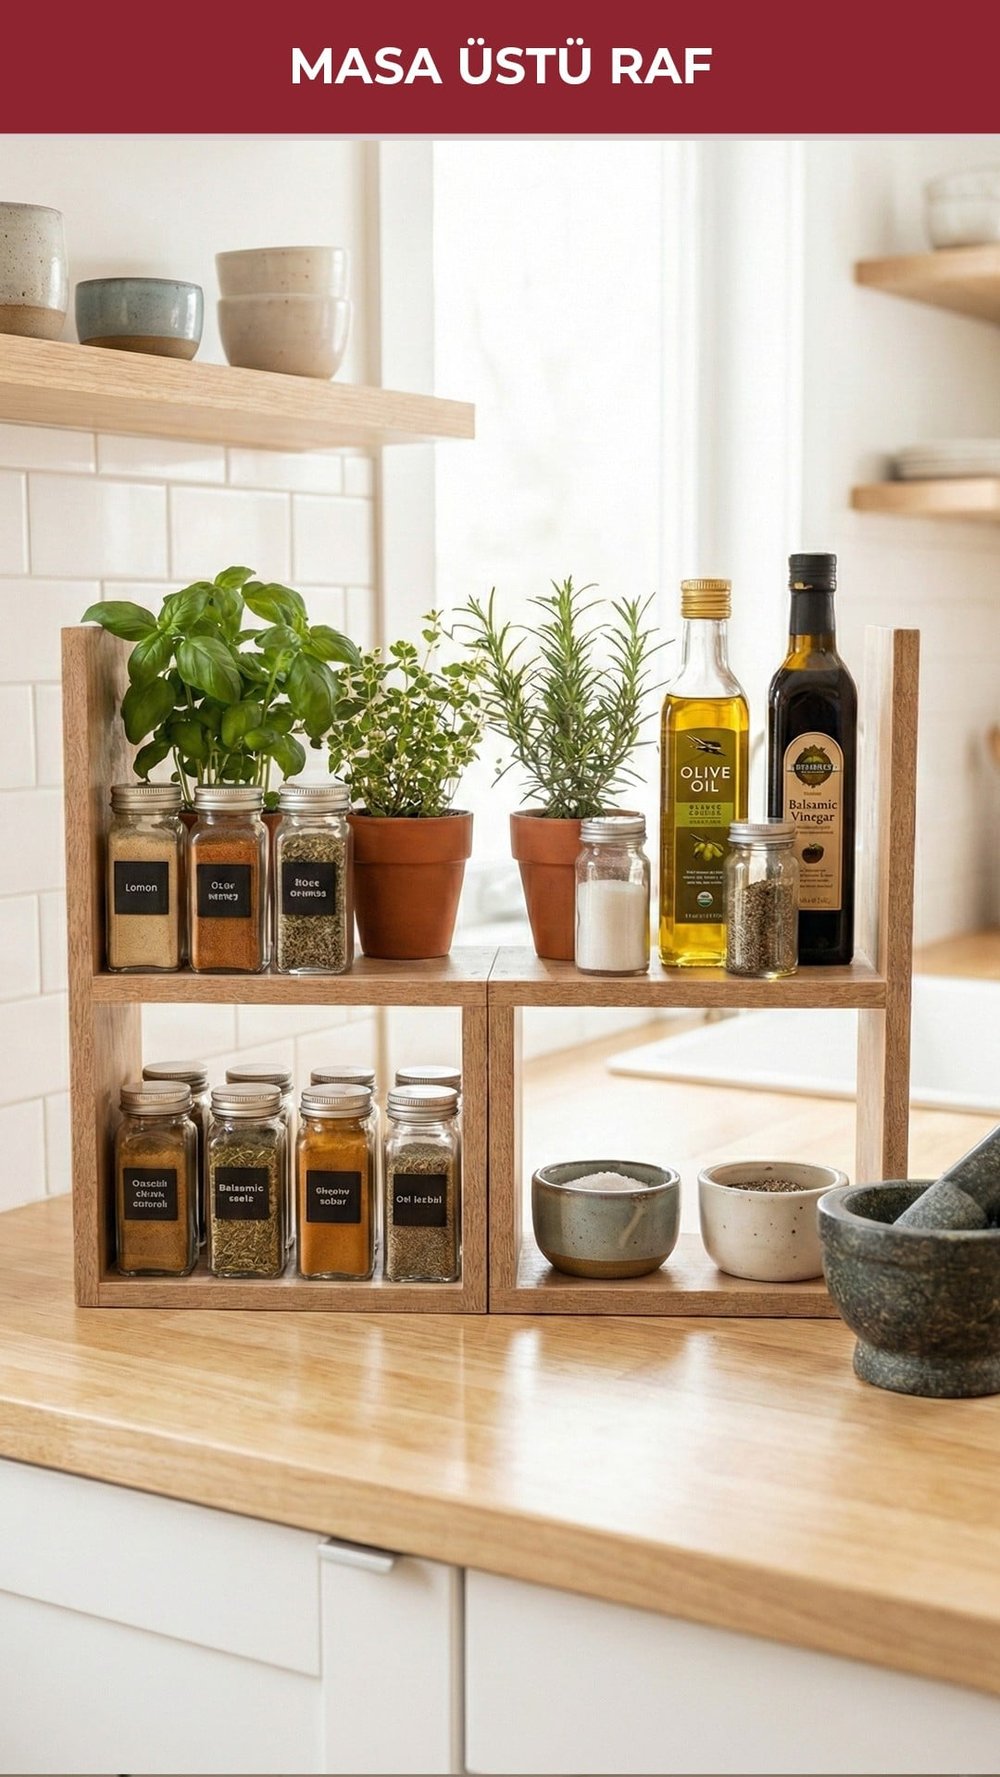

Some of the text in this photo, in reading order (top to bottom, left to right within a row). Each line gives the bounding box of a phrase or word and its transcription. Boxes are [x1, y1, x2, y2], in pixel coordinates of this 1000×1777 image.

[680, 766, 731, 779] OLIVE
[690, 780, 719, 792] OIL
[789, 799, 838, 810] Balsamic
[791, 812, 835, 825] Vinegar
[125, 883, 158, 892] Lomon
